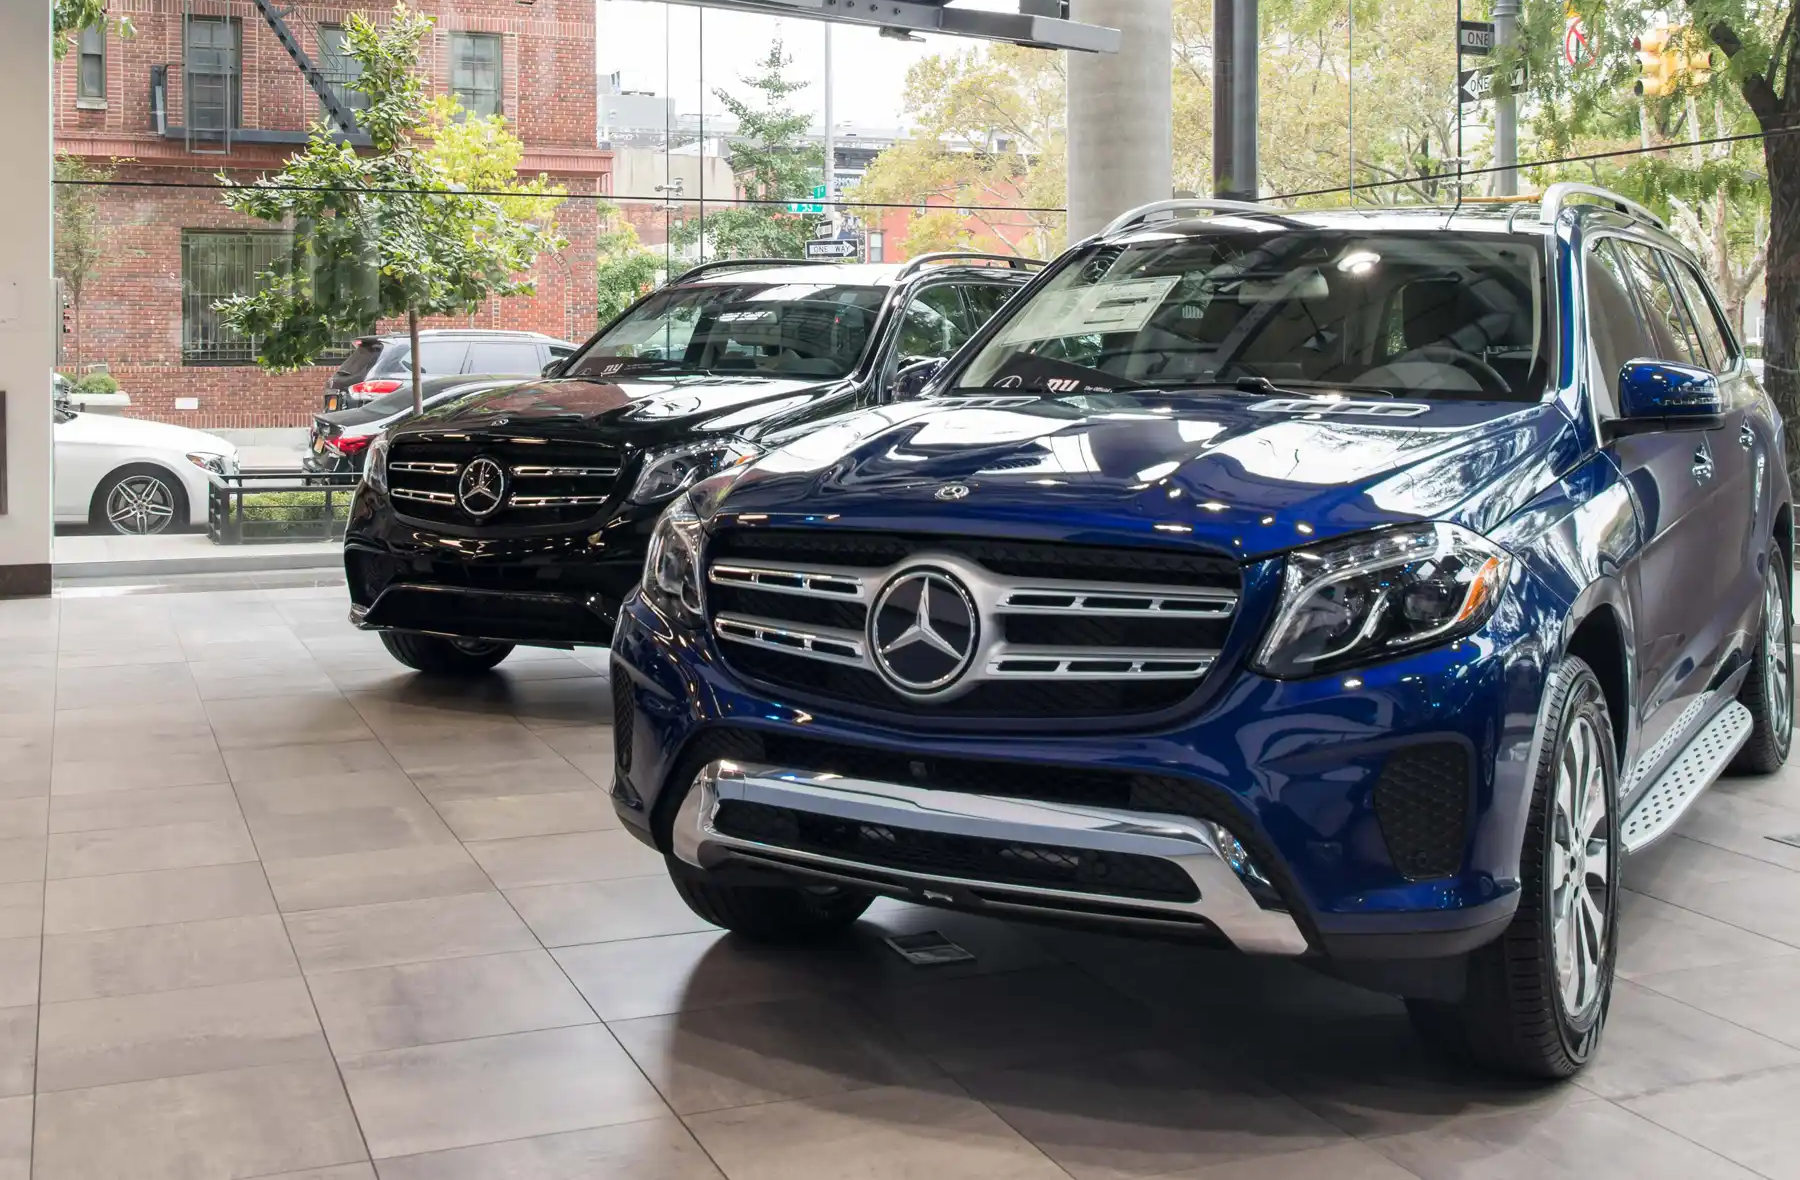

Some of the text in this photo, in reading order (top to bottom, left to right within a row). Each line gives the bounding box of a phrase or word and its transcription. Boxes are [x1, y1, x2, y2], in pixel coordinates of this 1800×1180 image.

[1467, 31, 1489, 46] ONE
[1470, 77, 1489, 92] ONE
[835, 245, 850, 253] WAY
